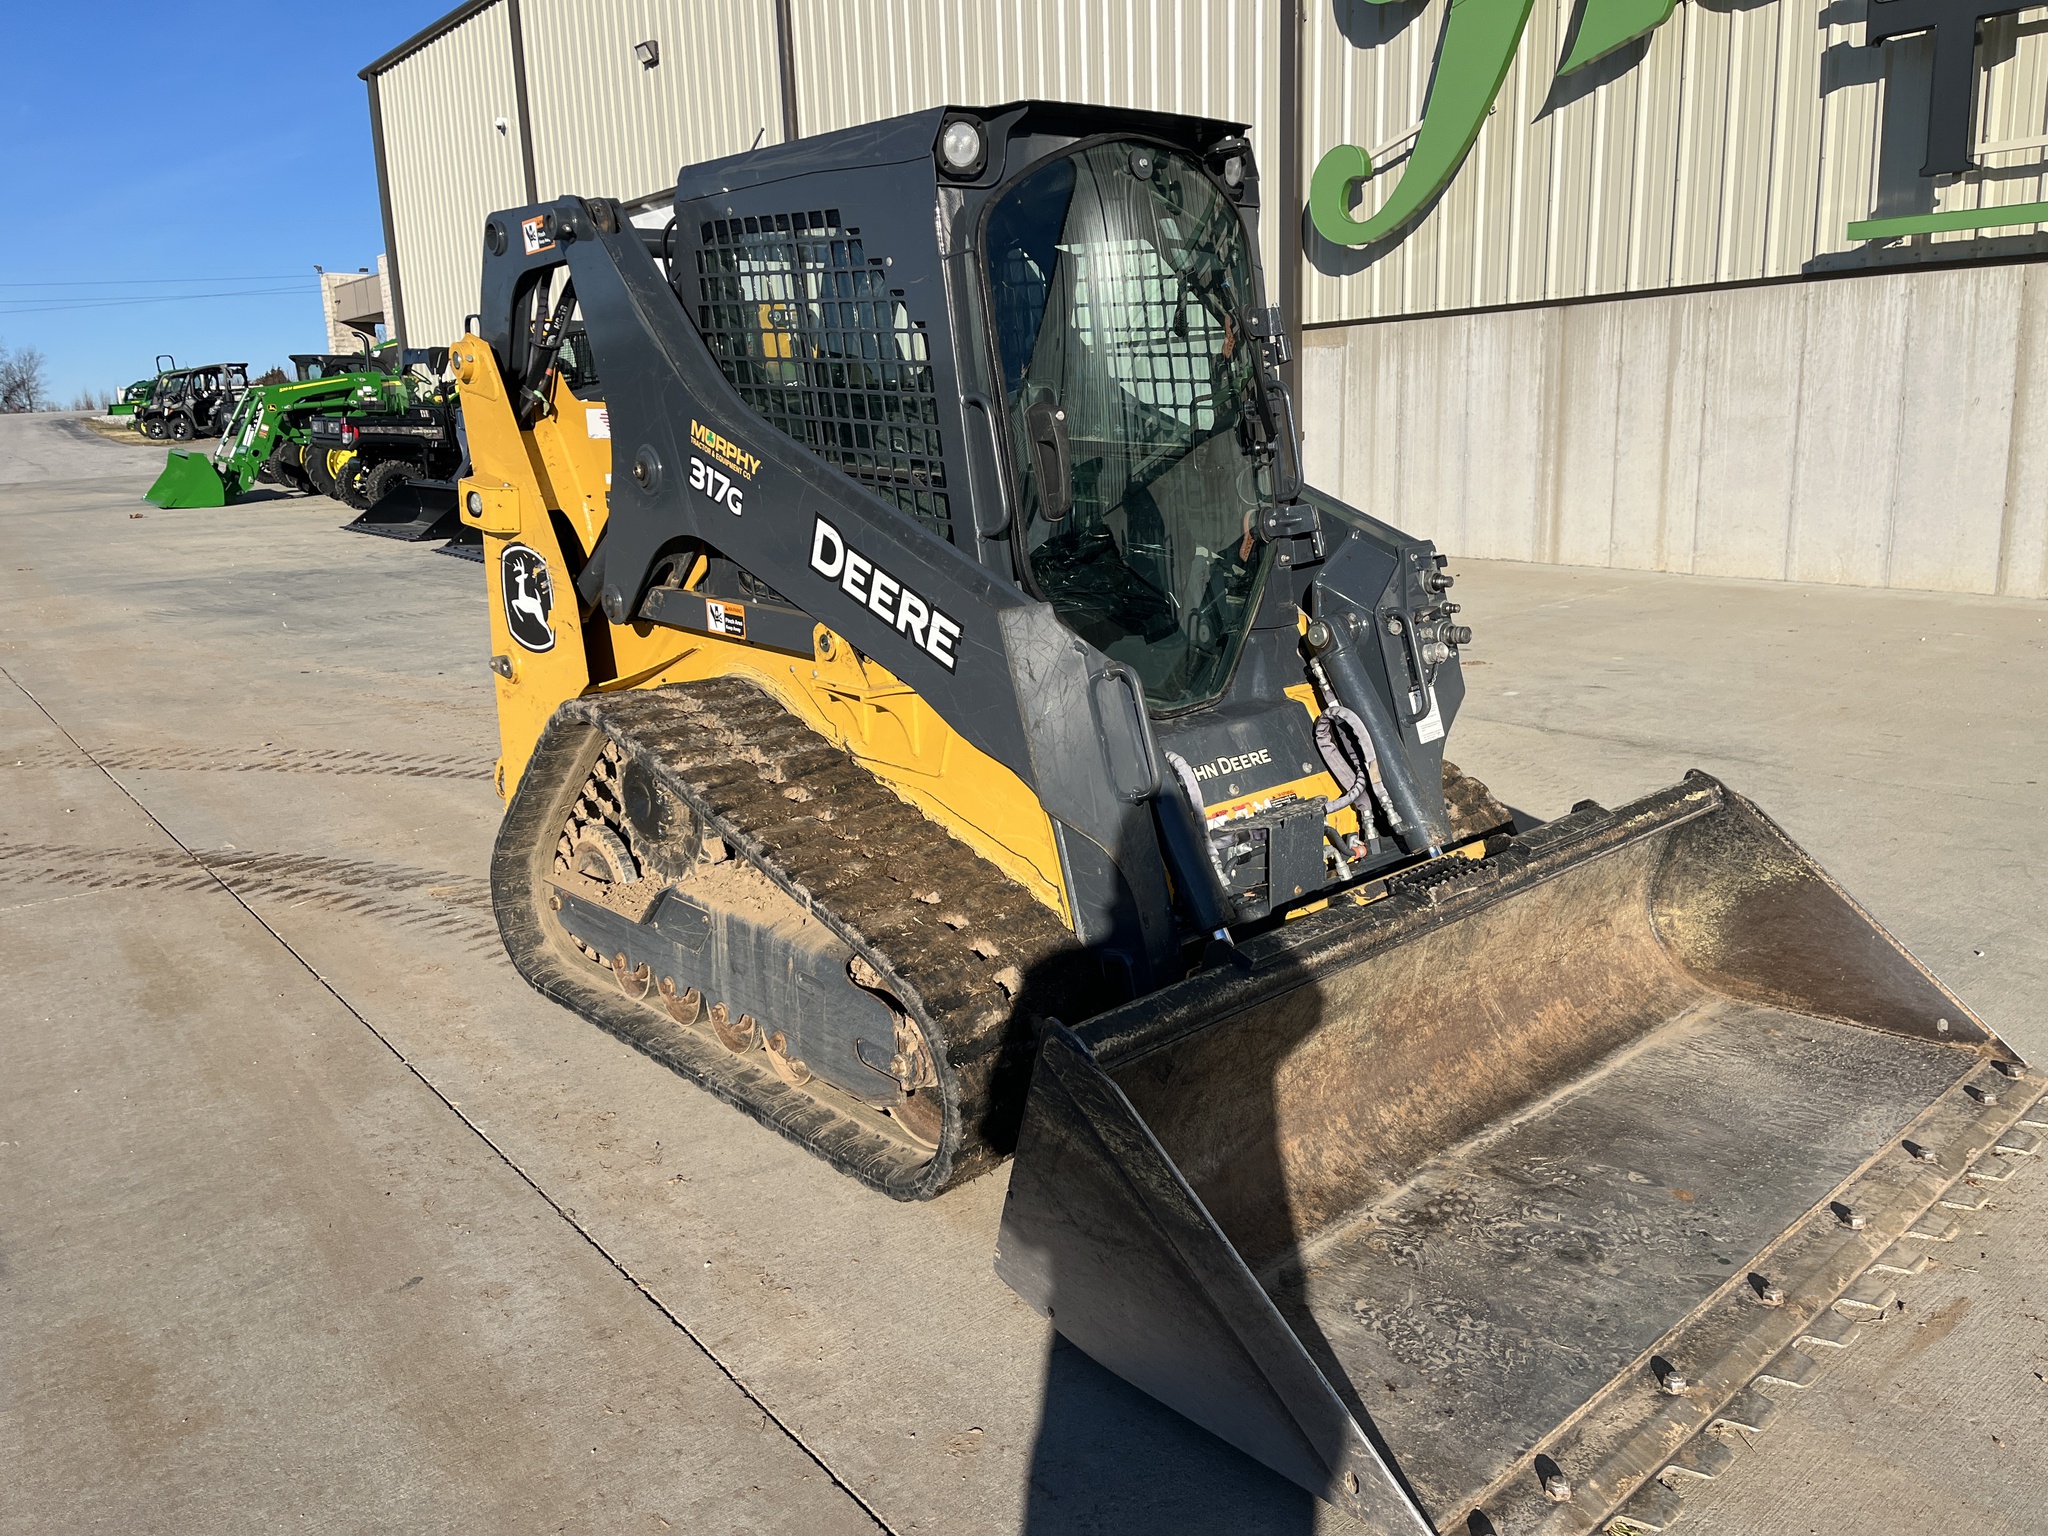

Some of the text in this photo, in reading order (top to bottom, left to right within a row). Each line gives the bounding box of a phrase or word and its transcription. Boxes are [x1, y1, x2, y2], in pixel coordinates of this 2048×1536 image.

[691, 419, 761, 475] MURPHY
[716, 453, 743, 475] EQUIPMENT
[742, 470, 752, 481] CO.
[689, 456, 743, 516] 317G
[811, 518, 961, 669] DEERE
[1217, 749, 1272, 775] DEERE
